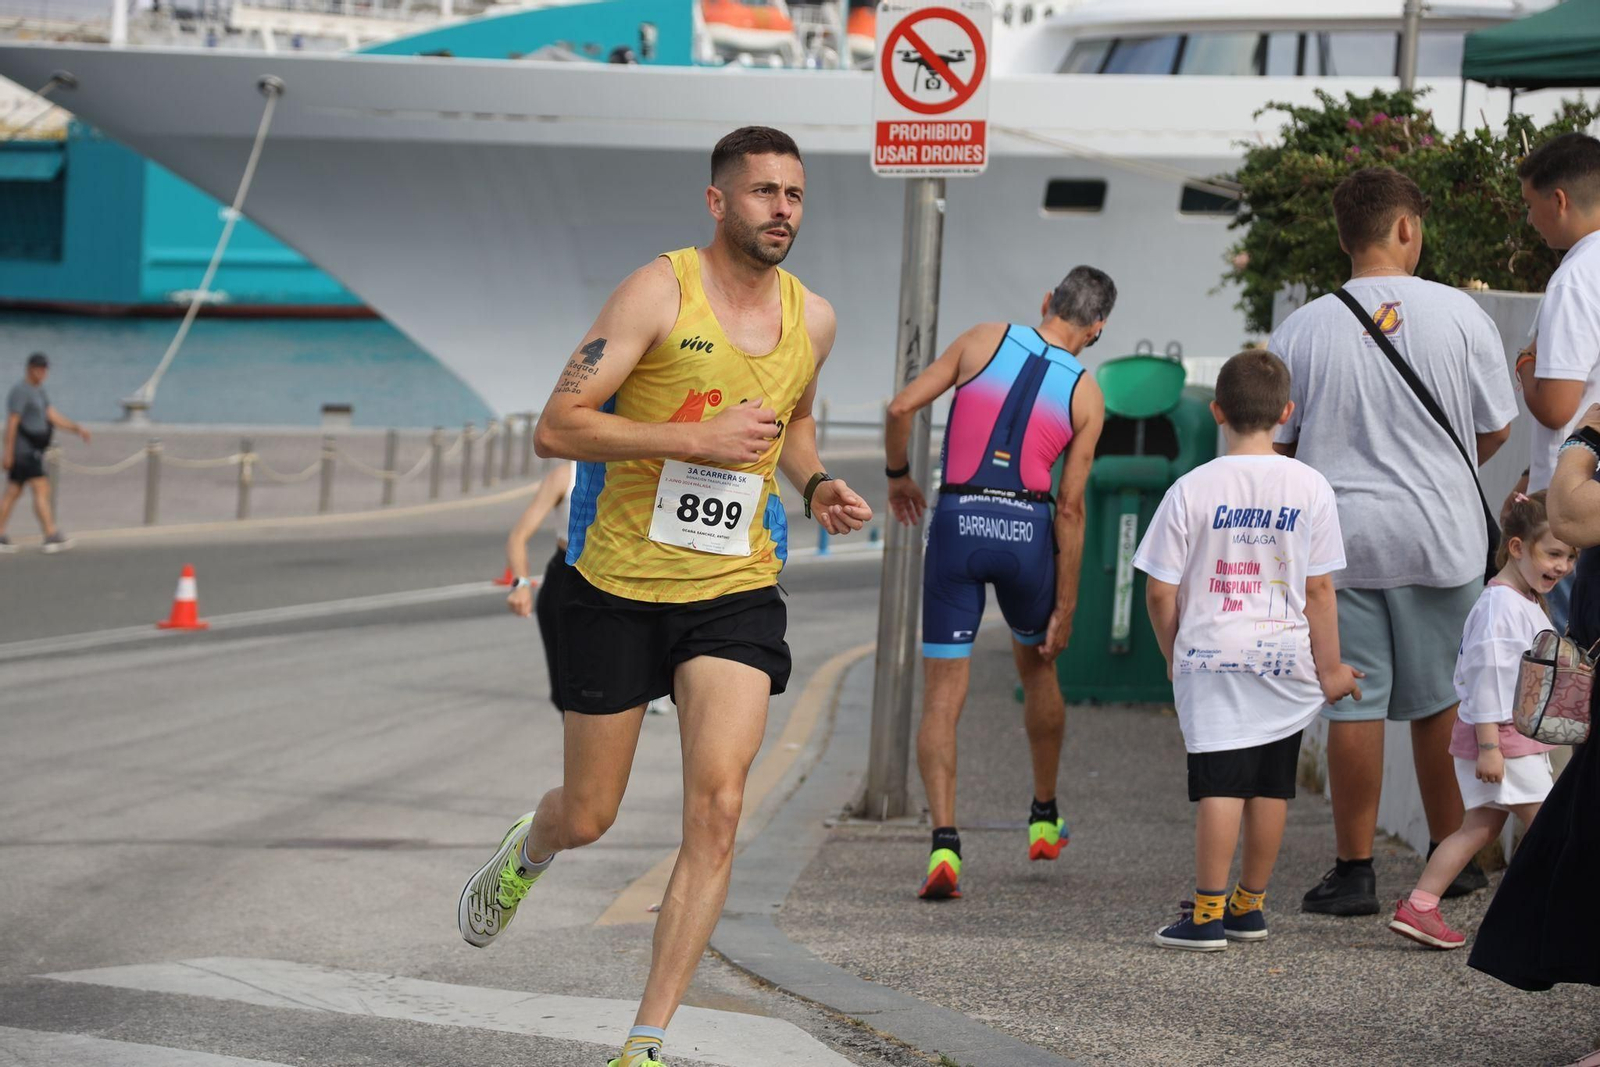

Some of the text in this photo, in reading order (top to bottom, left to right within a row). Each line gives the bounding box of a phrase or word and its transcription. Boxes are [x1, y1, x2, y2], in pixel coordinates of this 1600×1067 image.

[888, 123, 972, 142] PROHIBIDO
[876, 145, 984, 164] USAR DRONES
[579, 337, 607, 367] 4
[687, 467, 699, 475] 3A
[700, 469, 738, 482] CARRERA
[676, 493, 742, 530] 899
[1212, 505, 1301, 532] CARRERA 5K
[958, 514, 1034, 543] BARRANQUERO
[1232, 532, 1277, 546] MÁLAGA
[1215, 559, 1261, 576] DONACIÓN
[1209, 577, 1262, 594] TRASPLANTE
[1222, 597, 1243, 612] VIDA
